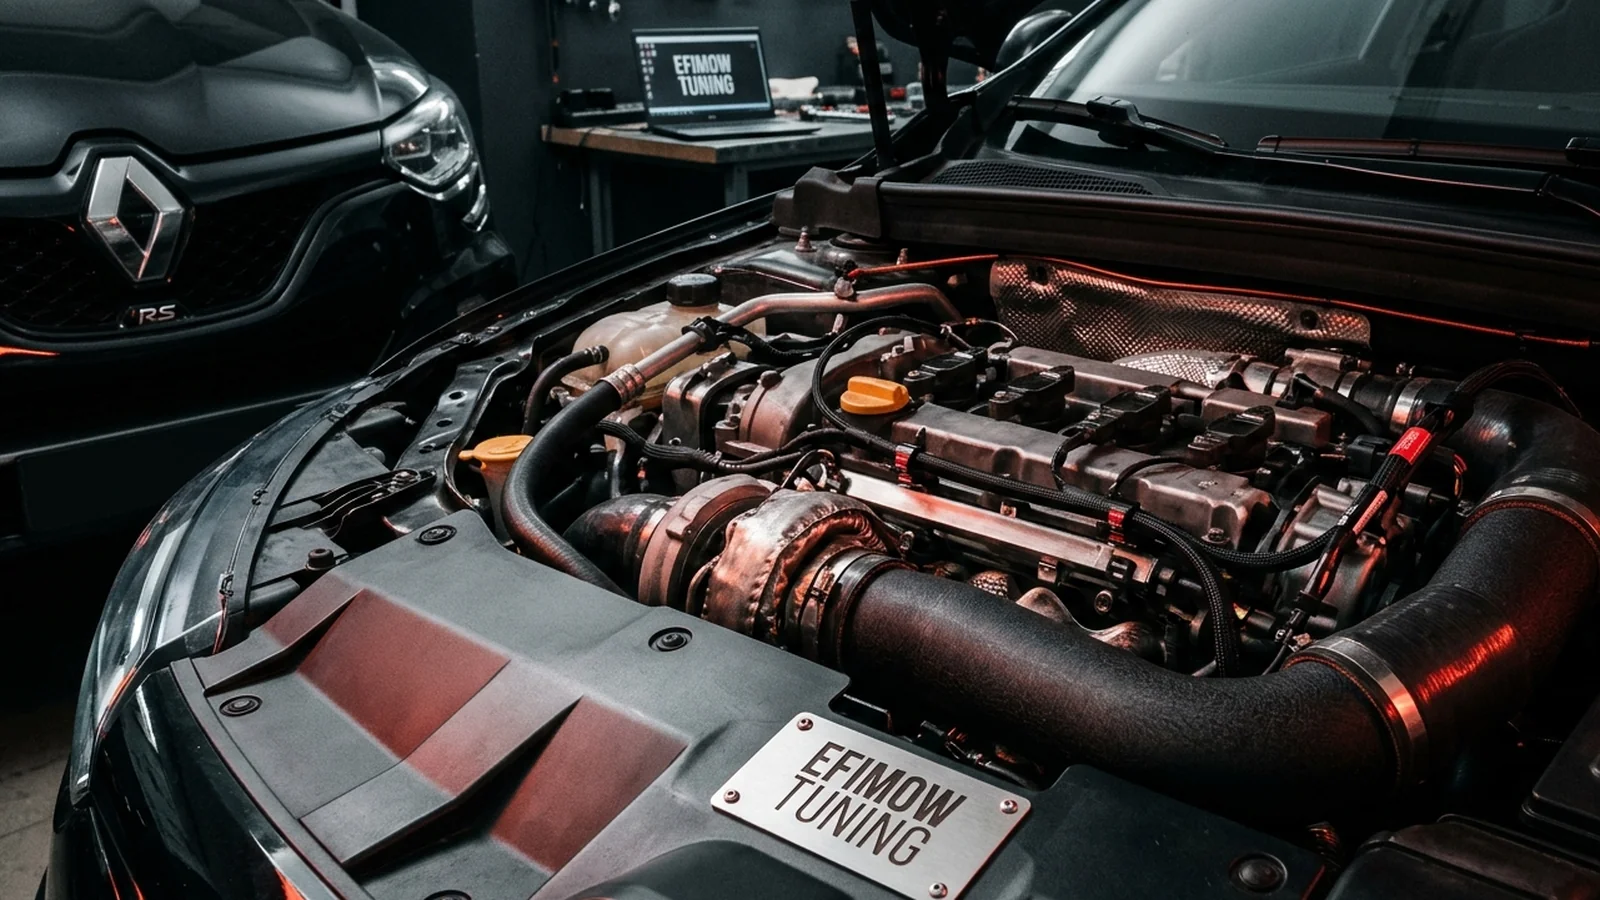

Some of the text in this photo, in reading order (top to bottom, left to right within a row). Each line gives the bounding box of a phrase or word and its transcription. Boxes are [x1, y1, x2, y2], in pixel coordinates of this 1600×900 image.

[673, 54, 732, 75] EFIMOW
[677, 74, 735, 96] TUNING
[139, 304, 176, 325] RS
[800, 741, 967, 828] EFIMOW
[775, 774, 931, 866] TUNING
